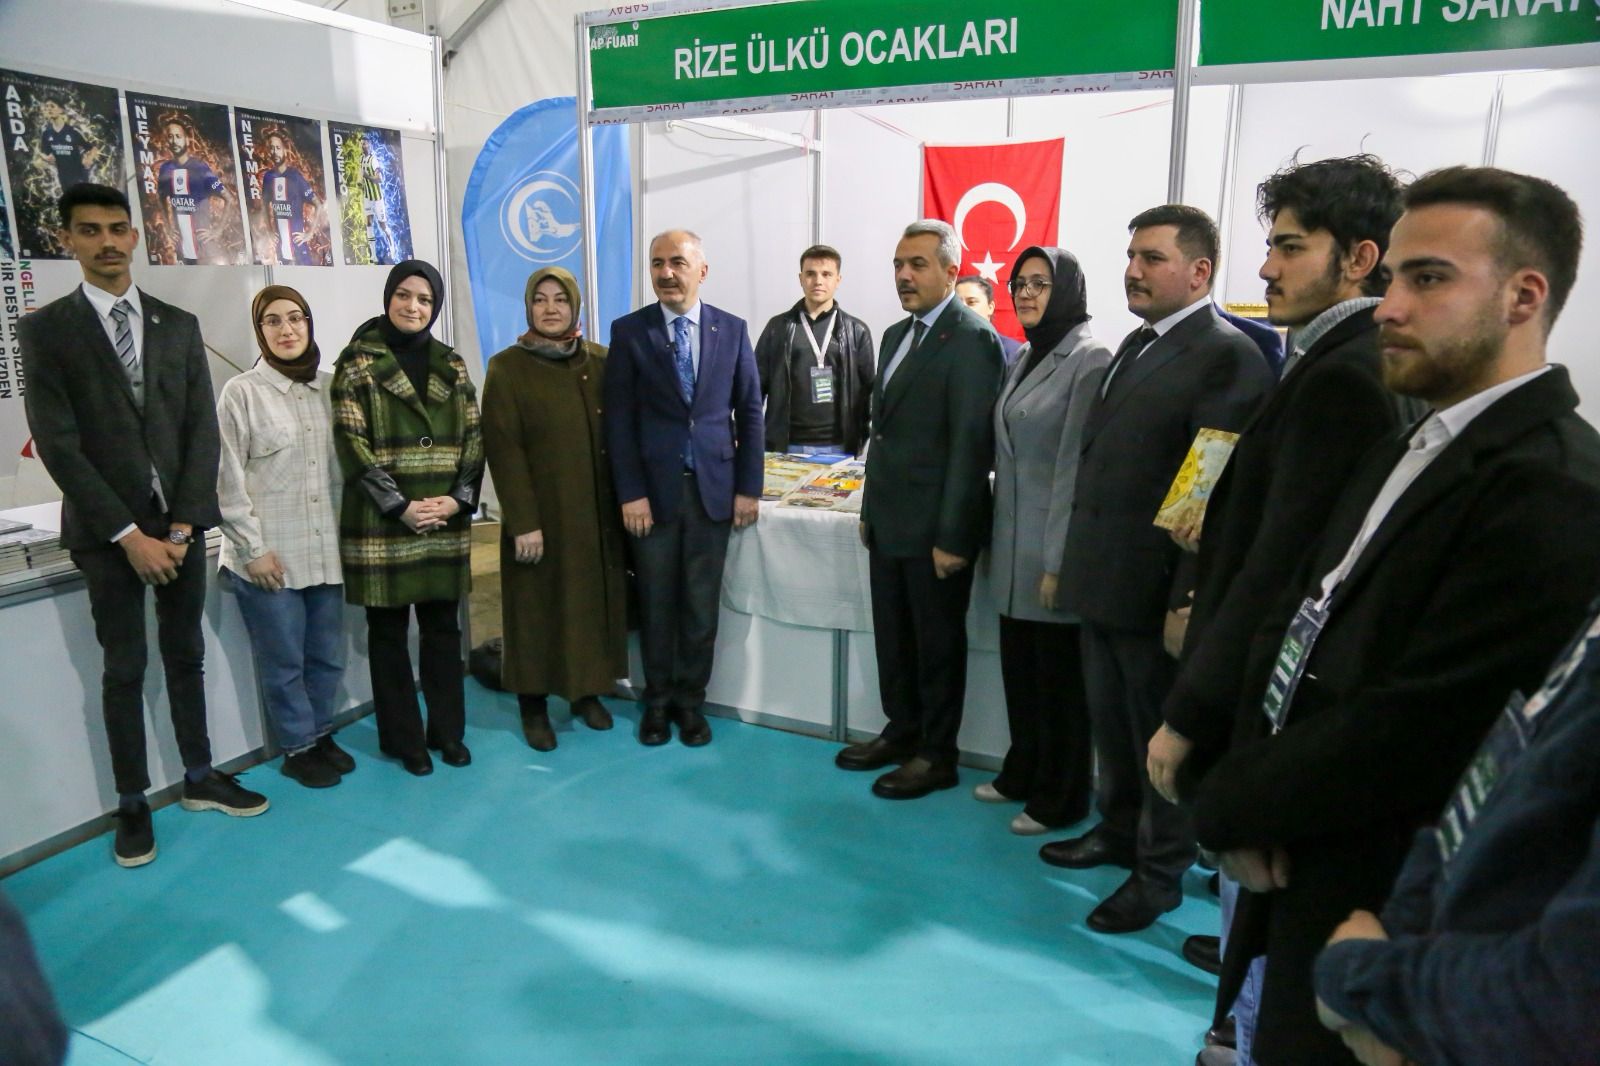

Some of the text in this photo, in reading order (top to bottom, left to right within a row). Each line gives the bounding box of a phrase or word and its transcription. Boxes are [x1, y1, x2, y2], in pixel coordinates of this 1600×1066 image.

[675, 17, 1018, 80] RİZE ÜLKÜ OCAKLARI
[5, 84, 29, 153] ARDA
[135, 105, 157, 194] NEYMAR
[241, 119, 261, 200] NEYMAR
[334, 133, 348, 196] DZEKO
